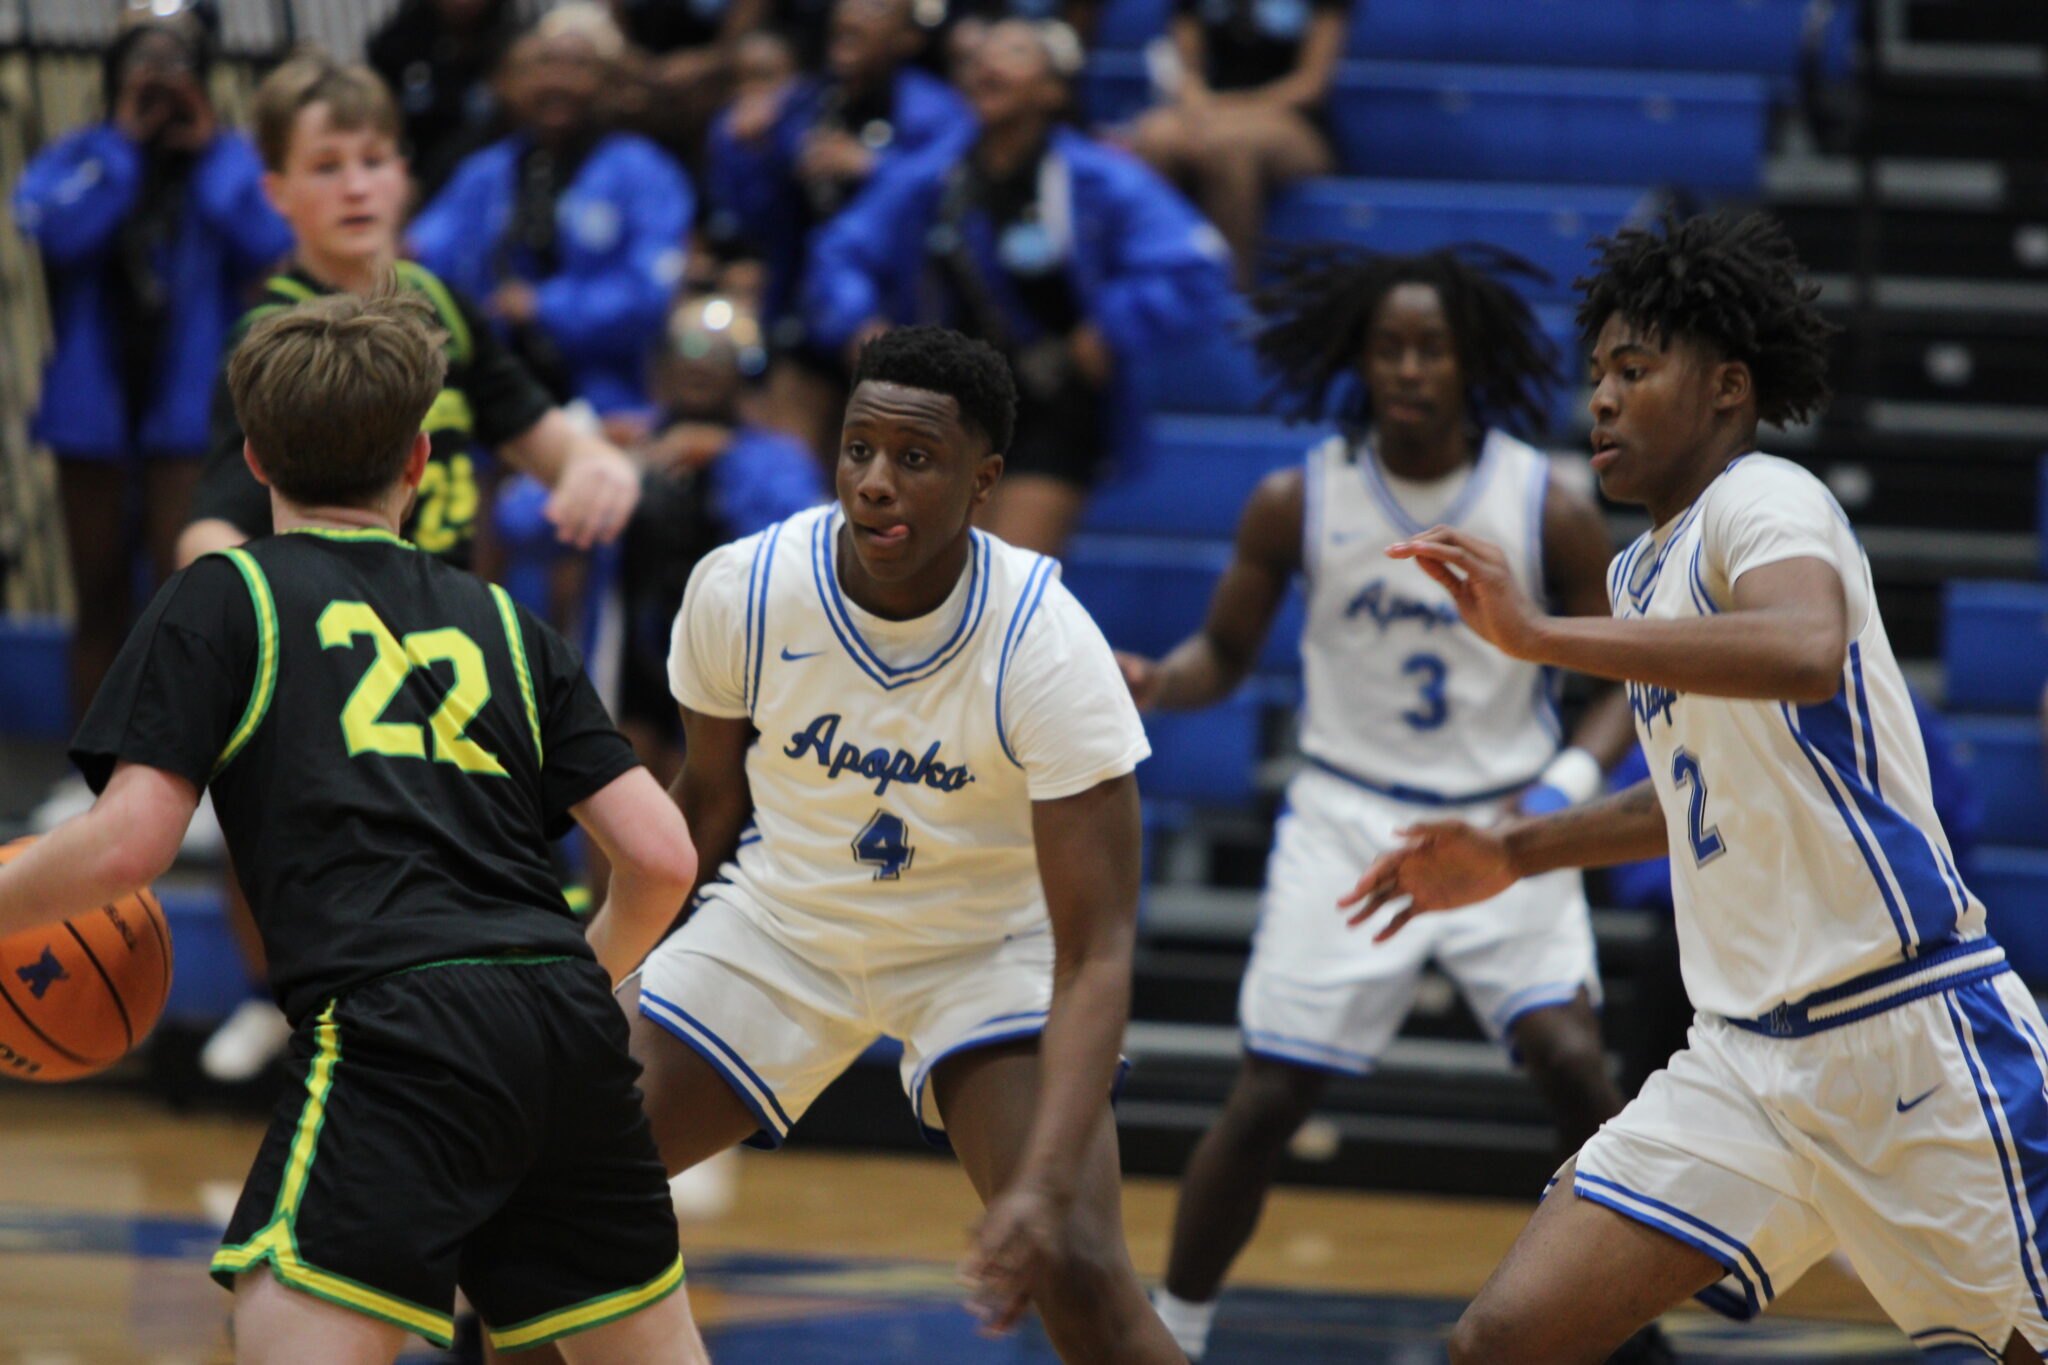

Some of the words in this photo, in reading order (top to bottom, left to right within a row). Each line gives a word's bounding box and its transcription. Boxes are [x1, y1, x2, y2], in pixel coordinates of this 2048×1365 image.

[316, 599, 511, 779] 22
[1401, 652, 1450, 732] 3
[783, 713, 976, 796] Apopka
[851, 808, 915, 882] 4
[1671, 744, 1727, 870] 2
